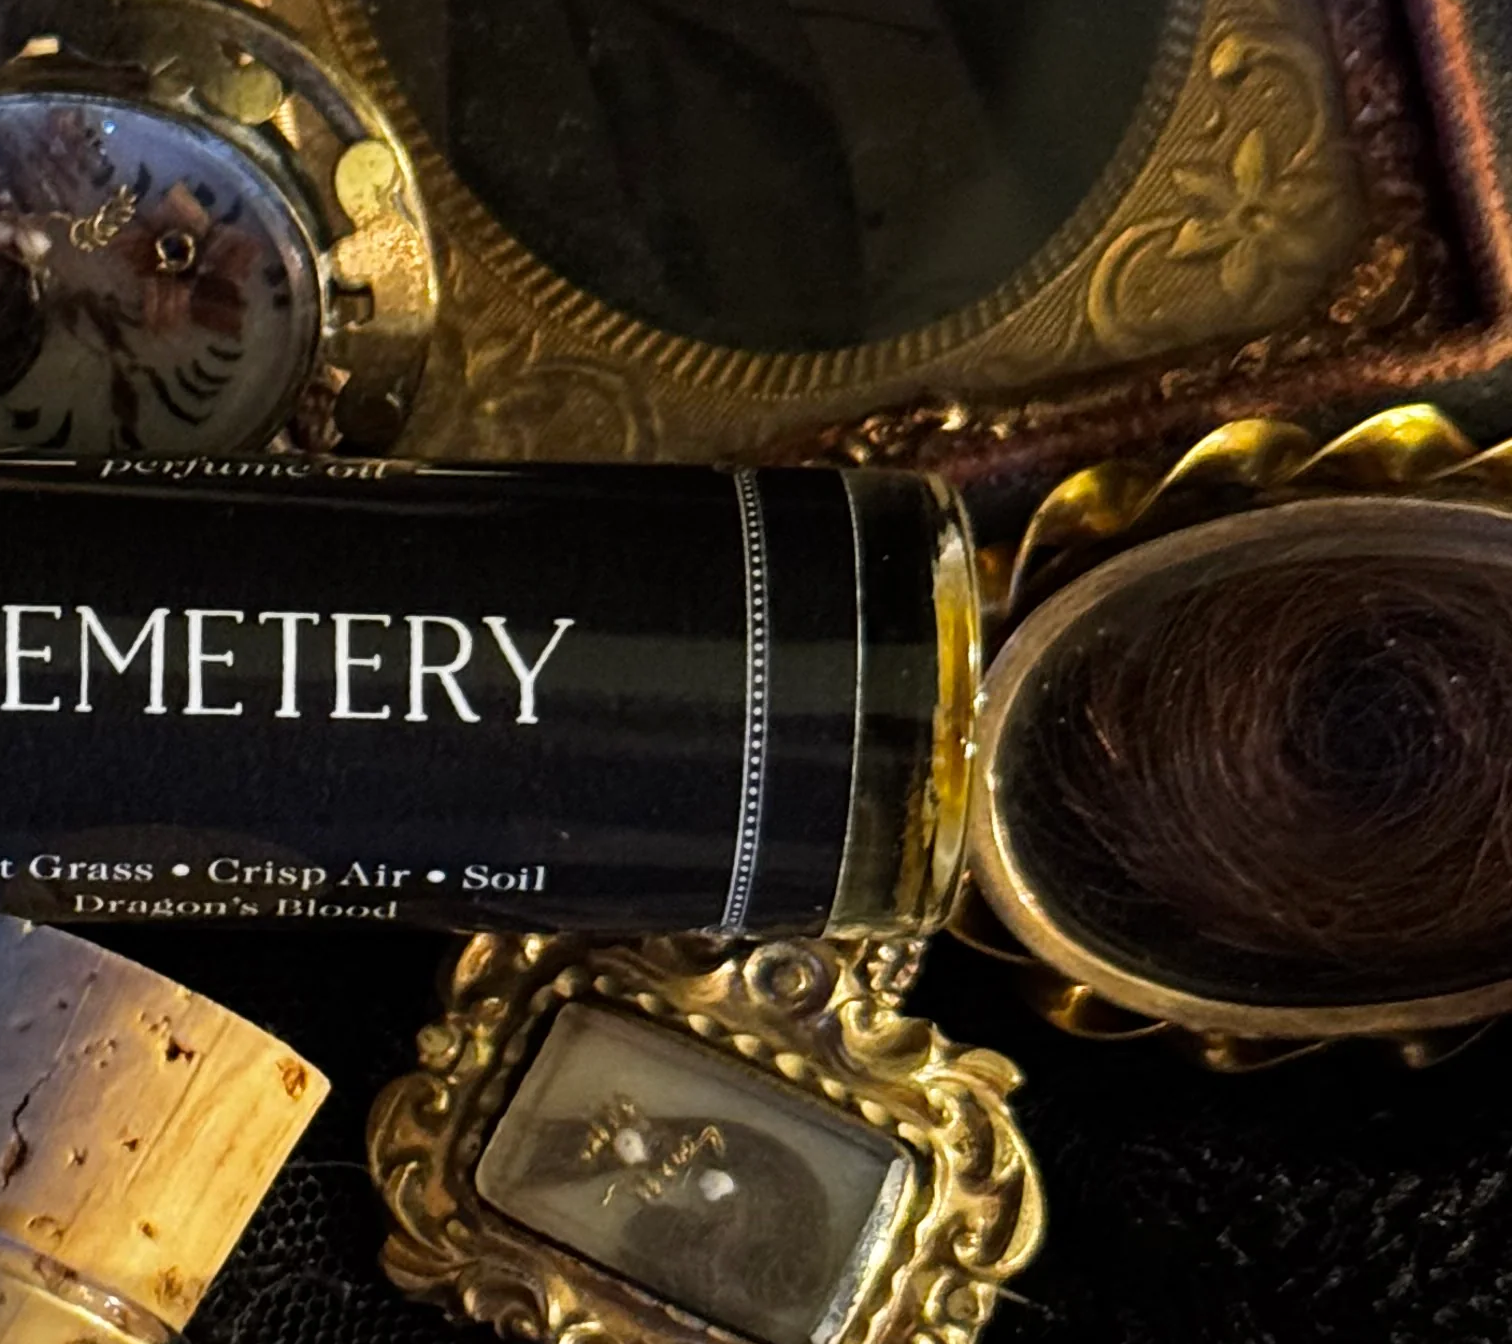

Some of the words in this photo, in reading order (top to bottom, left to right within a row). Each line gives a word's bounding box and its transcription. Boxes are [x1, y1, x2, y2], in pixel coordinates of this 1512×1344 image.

[99, 457, 312, 479] perfume
[27, 853, 155, 882] Grass
[206, 857, 328, 891] Crisp
[339, 860, 412, 889] Air
[461, 864, 546, 892] Soil
[275, 897, 398, 920] Blood
